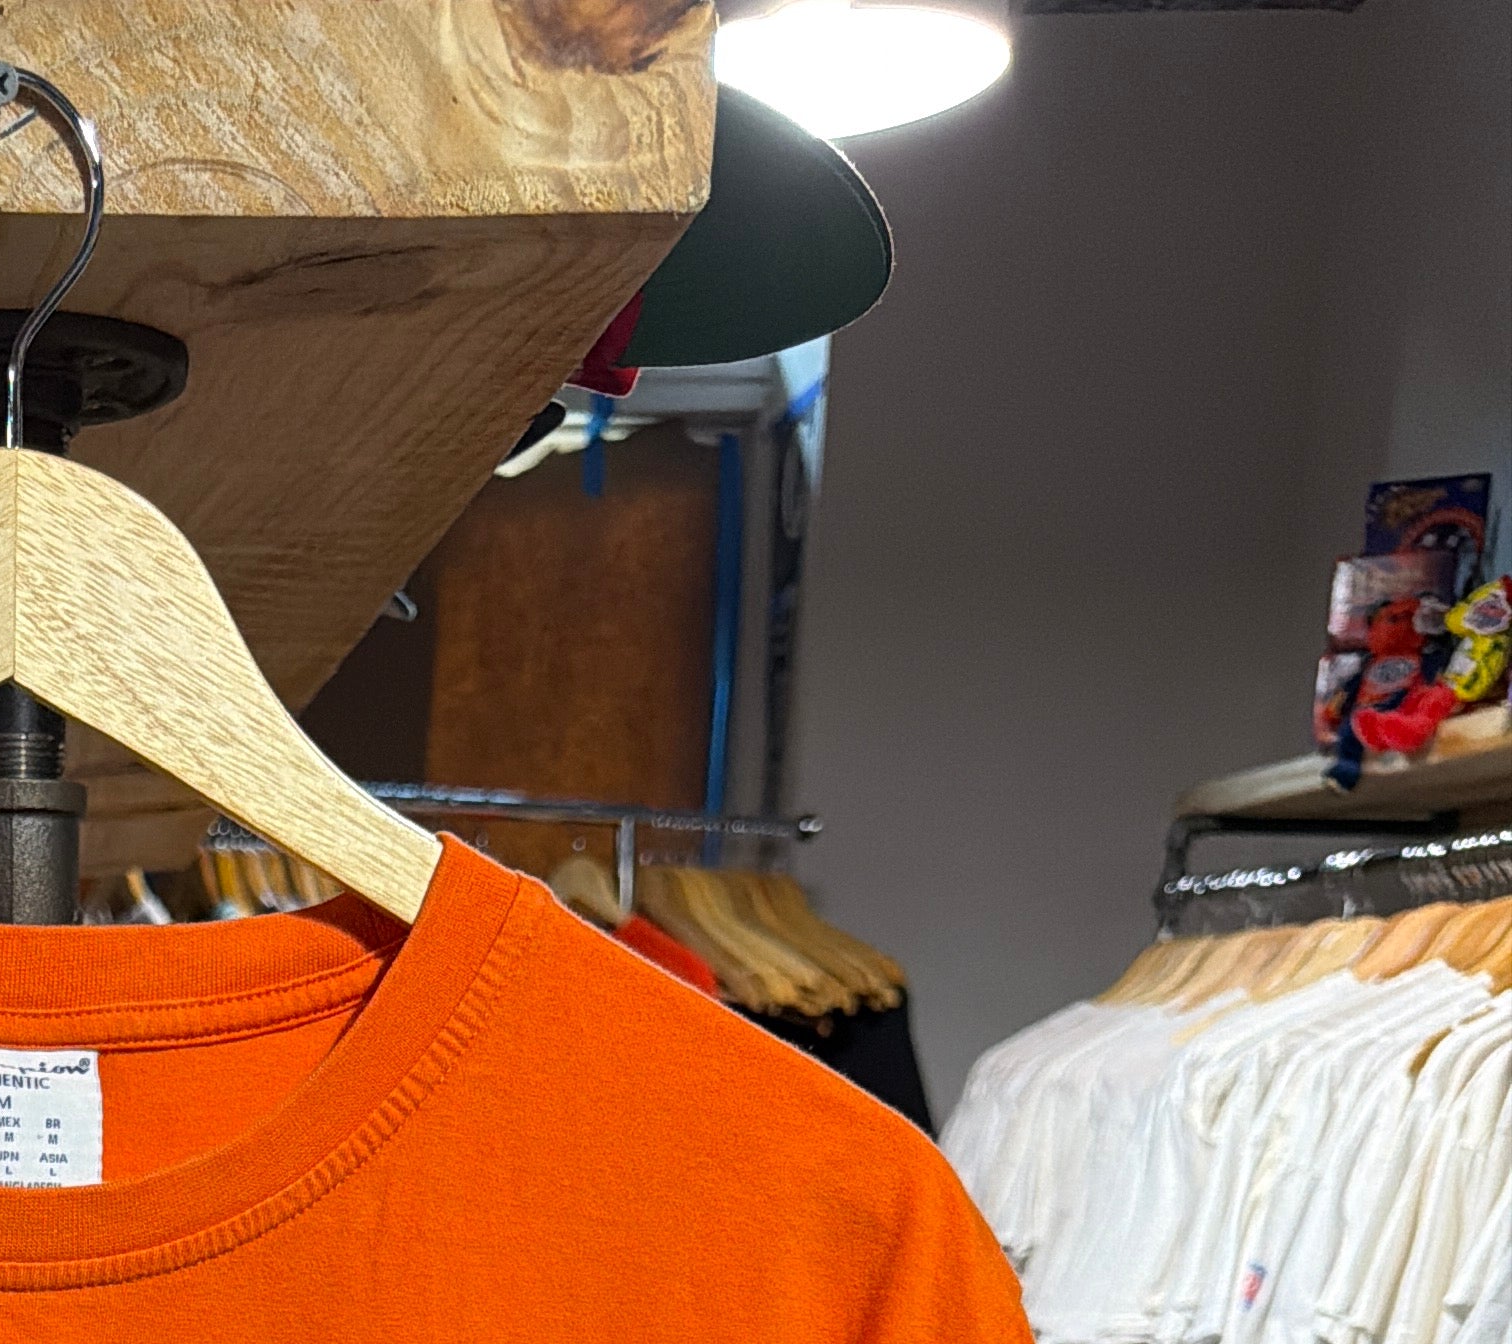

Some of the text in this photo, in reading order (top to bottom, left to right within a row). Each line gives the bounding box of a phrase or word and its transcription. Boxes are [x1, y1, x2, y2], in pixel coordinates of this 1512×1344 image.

[45, 1118, 61, 1129] BR
[4, 1132, 14, 1142] M
[48, 1134, 58, 1145] M
[39, 1153, 68, 1164] ASIA
[5, 1166, 13, 1175] L
[49, 1168, 57, 1177] L
